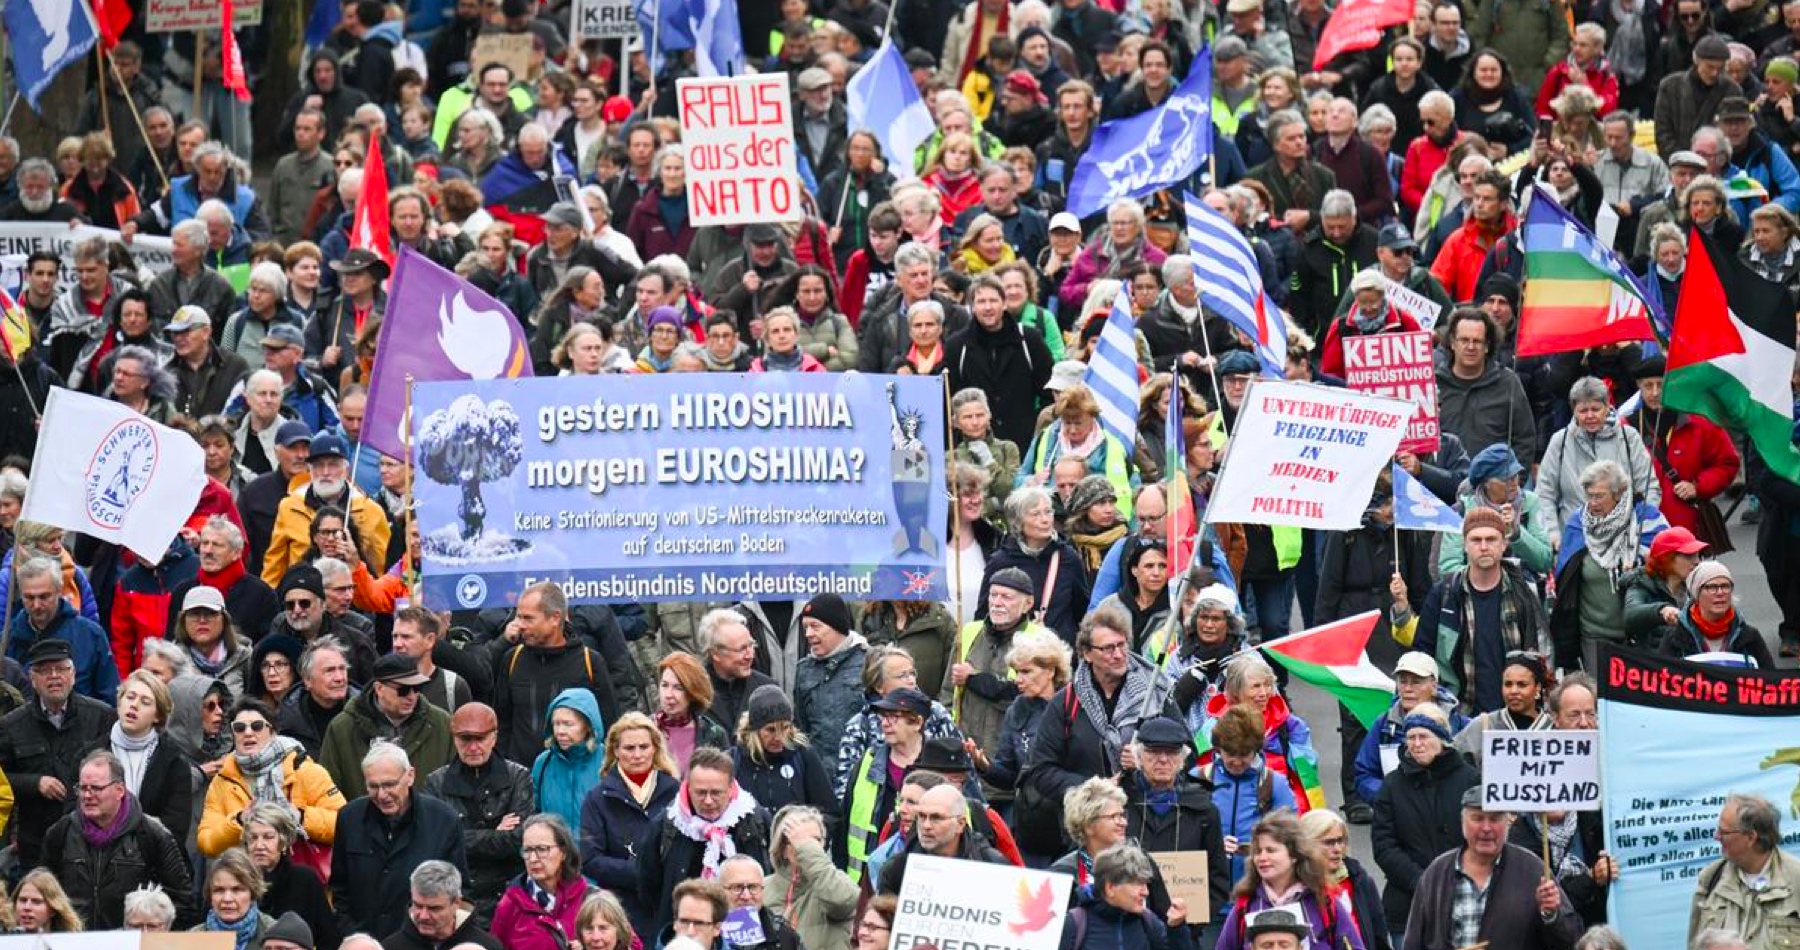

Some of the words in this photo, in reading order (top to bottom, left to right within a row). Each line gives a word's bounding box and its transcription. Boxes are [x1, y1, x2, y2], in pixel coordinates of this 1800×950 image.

[585, 5, 636, 23] KRIE
[682, 83, 783, 129] RAUS
[690, 142, 739, 171] aus
[743, 131, 789, 167] der
[692, 177, 791, 217] NATO
[1345, 334, 1432, 368] KEINE
[1347, 366, 1433, 385] AUFRÜSTUNG
[537, 397, 660, 442] gestern
[670, 391, 853, 429] HIROSHIMA
[1262, 397, 1402, 429] UNTERWÜRFIGE
[1273, 420, 1368, 447] FEIGLINGE
[1299, 445, 1323, 460] IN
[527, 456, 647, 494] morgen
[656, 446, 866, 484] EUROSHIMA?
[1268, 462, 1339, 484] MEDIEN
[514, 511, 552, 531] Keine
[558, 509, 658, 532] Stationierung
[664, 511, 689, 525] von
[695, 504, 887, 526] US-Mittelstreckenraketen
[1251, 497, 1325, 519] POLITIK
[623, 535, 649, 555] auf
[654, 533, 734, 554] deutschem
[740, 532, 785, 553] Boden
[701, 571, 872, 595] Norddeutschland
[1609, 656, 1728, 703] Deutsche
[1490, 737, 1592, 756] FRIEDEN
[1486, 780, 1599, 803] RUSSLAND
[1631, 797, 1655, 810] Die
[1614, 815, 1646, 829] sind
[1650, 813, 1719, 826] verantwo
[1616, 834, 1638, 848] für
[1642, 834, 1659, 847] 70
[1663, 830, 1679, 843] %
[1628, 852, 1657, 867] und
[1660, 850, 1696, 862] allen
[1700, 845, 1720, 857] Wa
[1661, 867, 1675, 881] in
[902, 898, 1002, 926] BÜNDNIS
